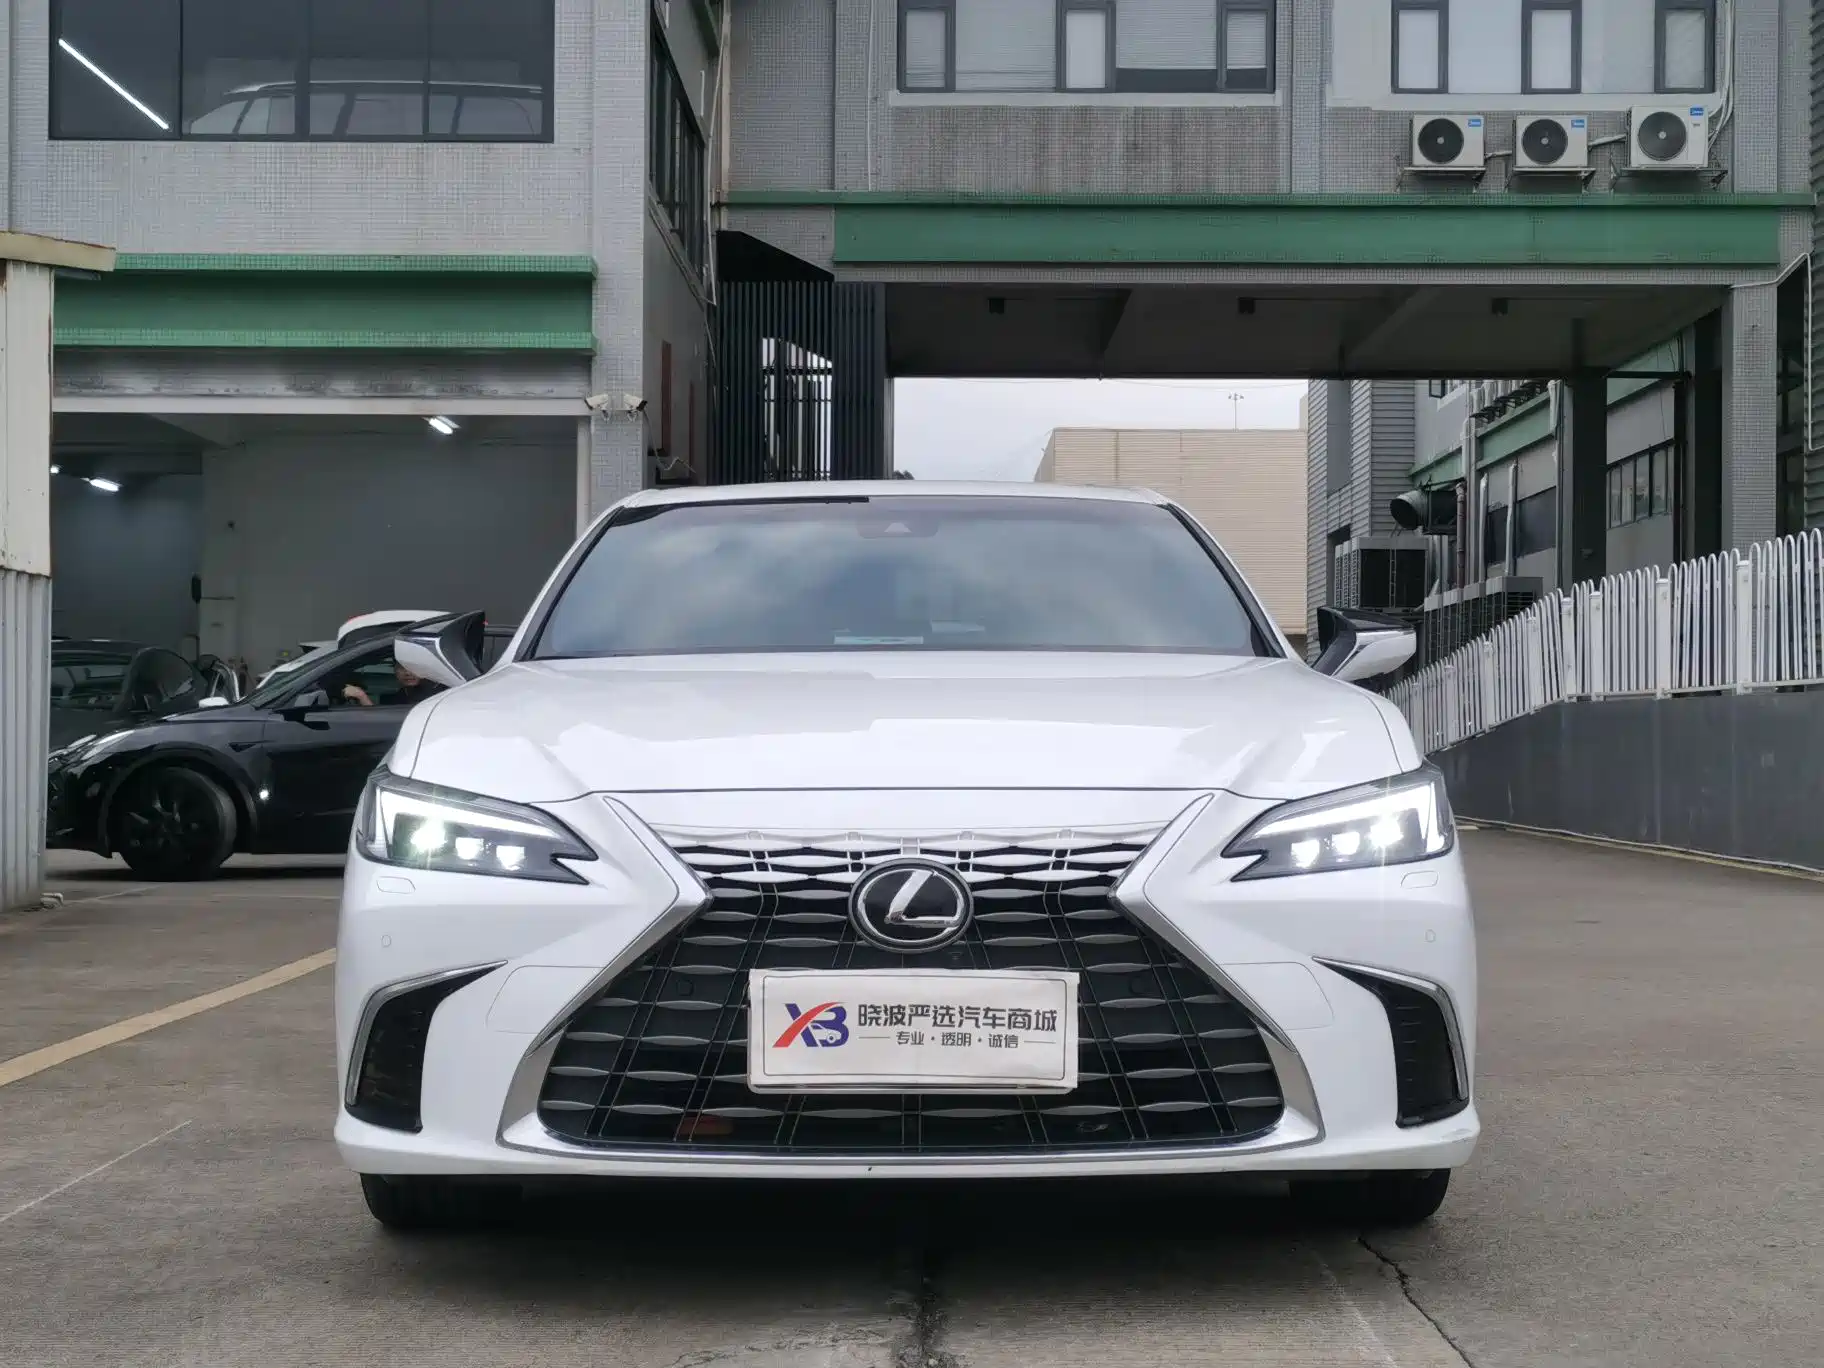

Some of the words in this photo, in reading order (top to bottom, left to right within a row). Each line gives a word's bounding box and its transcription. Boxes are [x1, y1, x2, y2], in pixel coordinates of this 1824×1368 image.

[857, 1003, 1058, 1032] 晓波严选汽车商城
